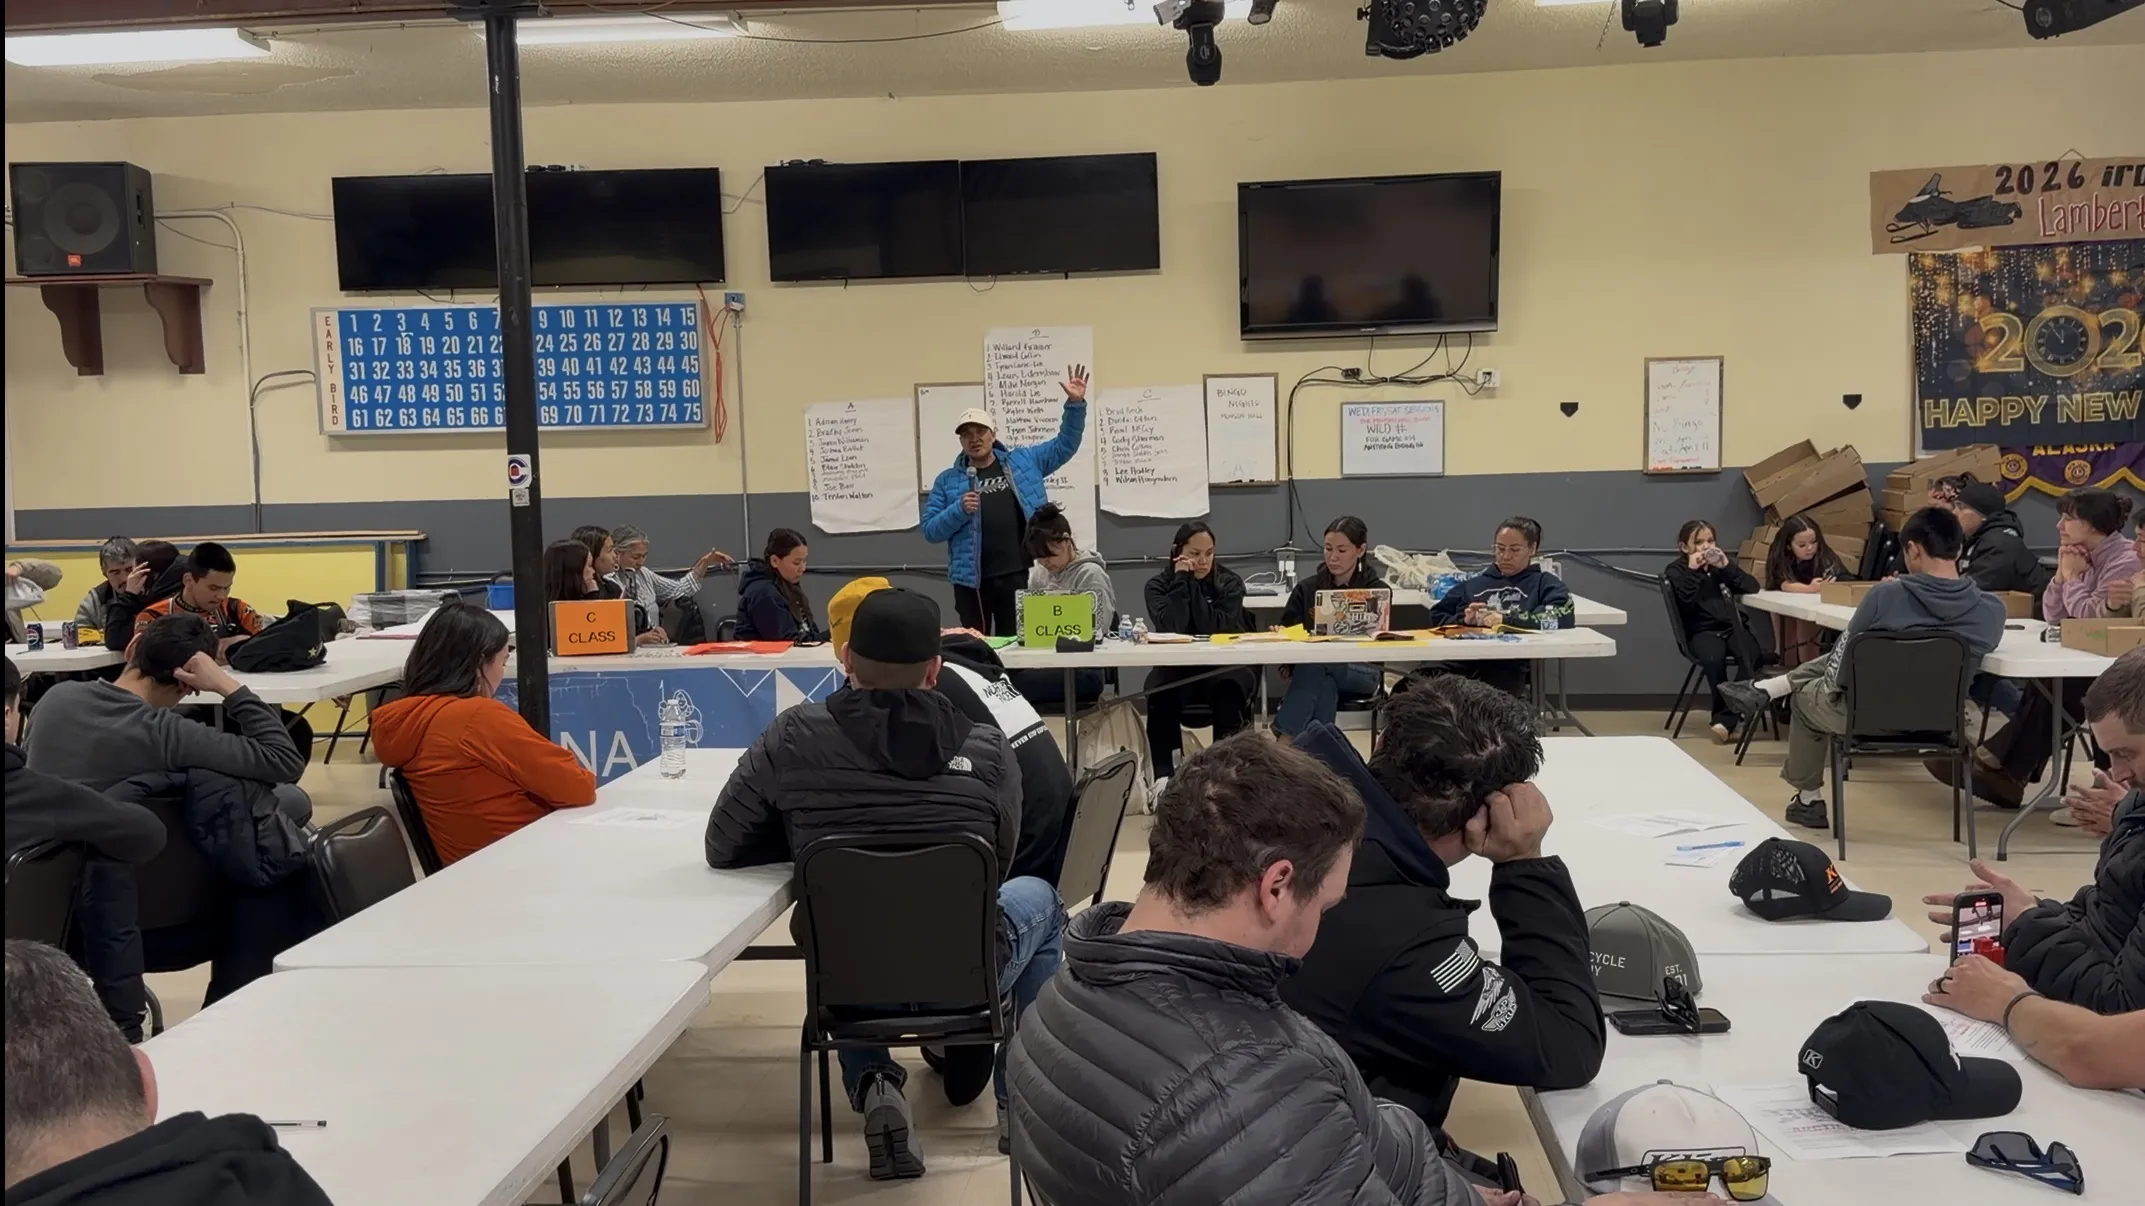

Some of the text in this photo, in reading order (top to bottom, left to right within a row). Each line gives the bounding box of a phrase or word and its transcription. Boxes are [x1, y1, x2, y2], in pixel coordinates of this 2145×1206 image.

[1994, 161, 2086, 195] 2026
[351, 315, 356, 332] 1
[374, 314, 381, 331] 2
[397, 313, 405, 331] 3
[421, 313, 429, 330] 4
[445, 312, 453, 330] 5
[469, 312, 477, 329] 6
[539, 311, 547, 328] 9
[560, 310, 574, 327] 10
[585, 310, 597, 327] 11
[608, 309, 623, 327] 12
[632, 309, 646, 326] 13
[656, 308, 670, 325] 14
[682, 307, 696, 324] 15
[348, 338, 363, 356] 16
[372, 338, 386, 355] 17
[396, 337, 411, 354] 18
[420, 337, 434, 354] 19
[443, 336, 459, 354] 20
[468, 336, 482, 353] 21
[536, 335, 553, 352] 24
[560, 334, 576, 351] 25
[584, 333, 601, 351] 26
[608, 333, 624, 351] 27
[633, 332, 649, 350] 28
[656, 332, 673, 350] 29
[681, 331, 697, 349] 30
[1979, 305, 2145, 377] 202
[350, 362, 365, 379] 31
[373, 362, 390, 379] 32
[397, 361, 414, 379] 33
[420, 361, 437, 378] 34
[444, 360, 461, 378] 35
[468, 359, 485, 377] 36
[538, 358, 555, 376] 39
[562, 358, 579, 375] 40
[587, 357, 601, 374] 41
[610, 357, 627, 374] 42
[634, 356, 651, 374] 43
[658, 356, 675, 373] 44
[682, 355, 699, 373] 45
[350, 386, 368, 404] 46
[375, 385, 391, 403] 47
[399, 385, 415, 402] 48
[422, 384, 439, 402] 49
[446, 384, 463, 402] 50
[471, 384, 485, 401] 51
[539, 382, 556, 400] 54
[564, 382, 580, 399] 55
[588, 381, 604, 399] 56
[612, 381, 628, 399] 57
[635, 381, 652, 398] 58
[659, 380, 676, 398] 59
[683, 380, 700, 397] 60
[329, 383, 339, 427] BIRD
[353, 404, 700, 427] 61 62 63 64 65 66 6 69 70 71 72 73 74 75
[1924, 391, 2141, 428] HAPPY NEW
[586, 612, 597, 623] C
[1053, 605, 1063, 616] B
[568, 629, 616, 645] CLASS
[1035, 624, 1082, 637] CLASS
[1665, 963, 1683, 976] EST.
